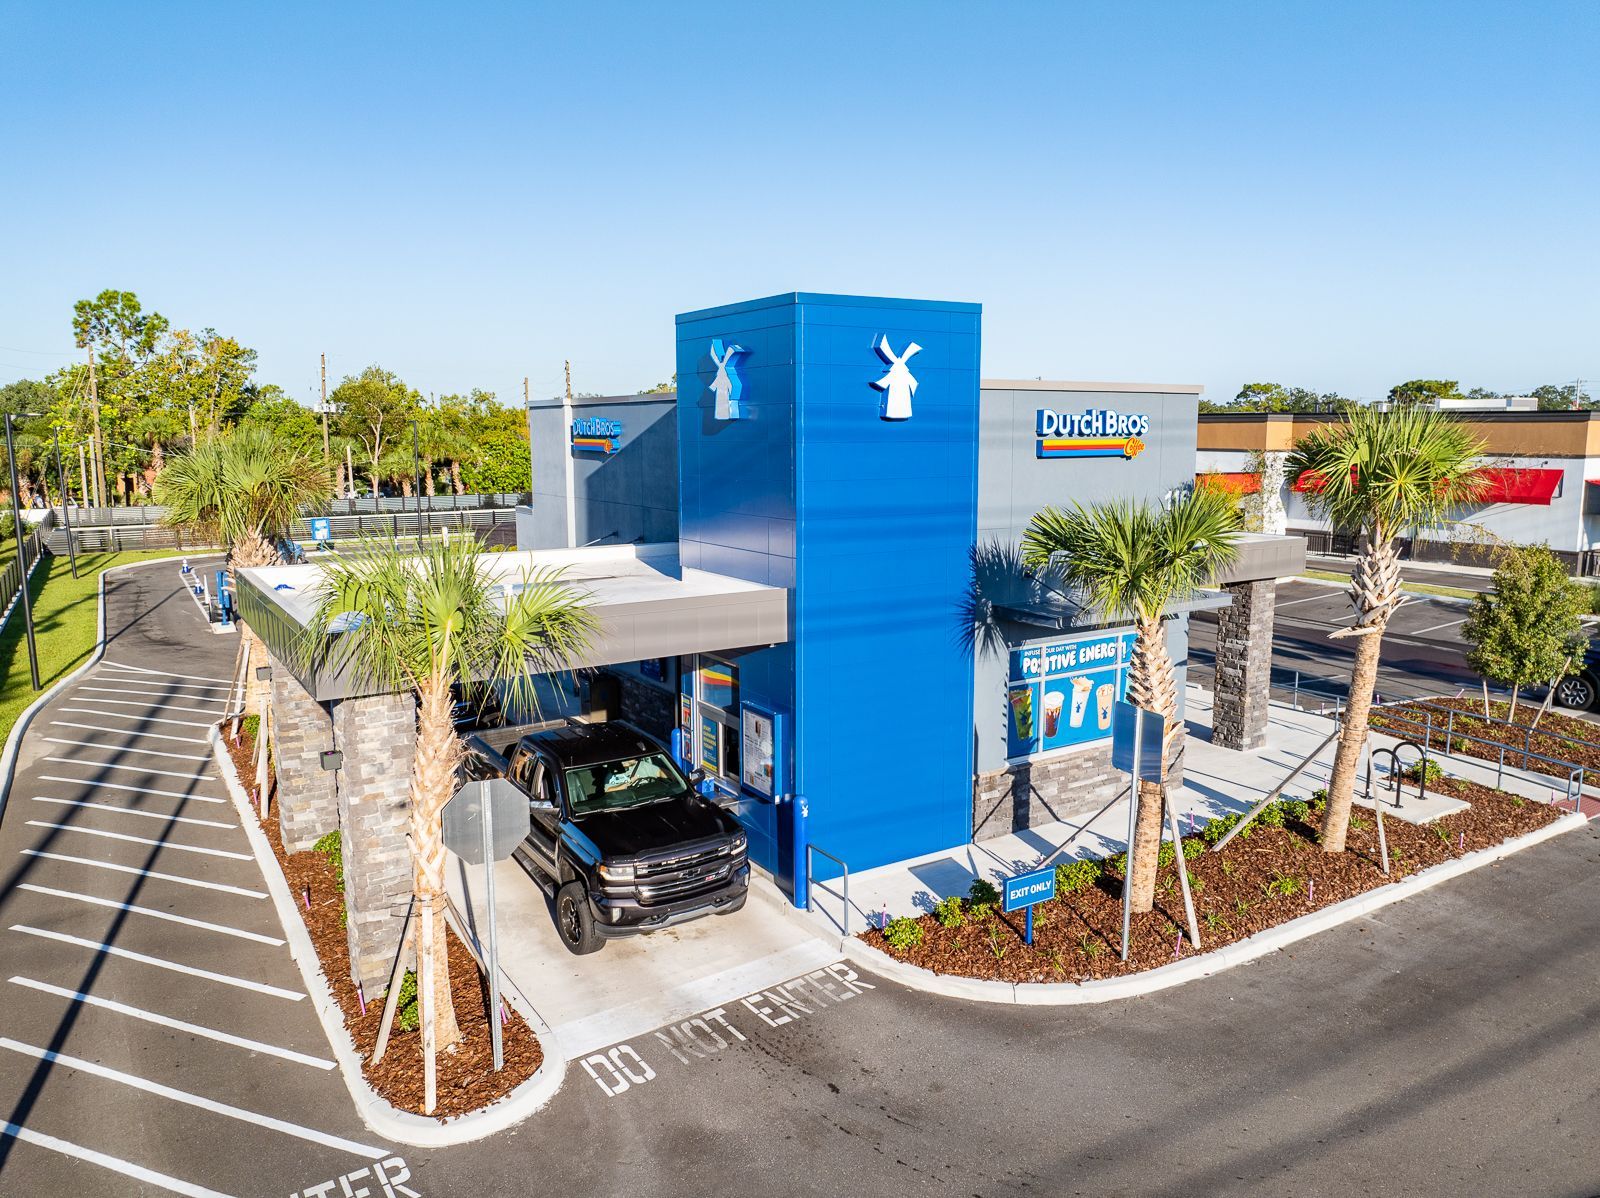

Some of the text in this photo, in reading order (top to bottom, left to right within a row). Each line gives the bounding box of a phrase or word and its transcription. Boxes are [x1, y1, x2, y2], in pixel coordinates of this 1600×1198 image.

[1042, 409, 1149, 434] DUTCH BROS
[1011, 880, 1051, 899] EXIT ONLY
[579, 963, 876, 1098] DO NOT ENTER
